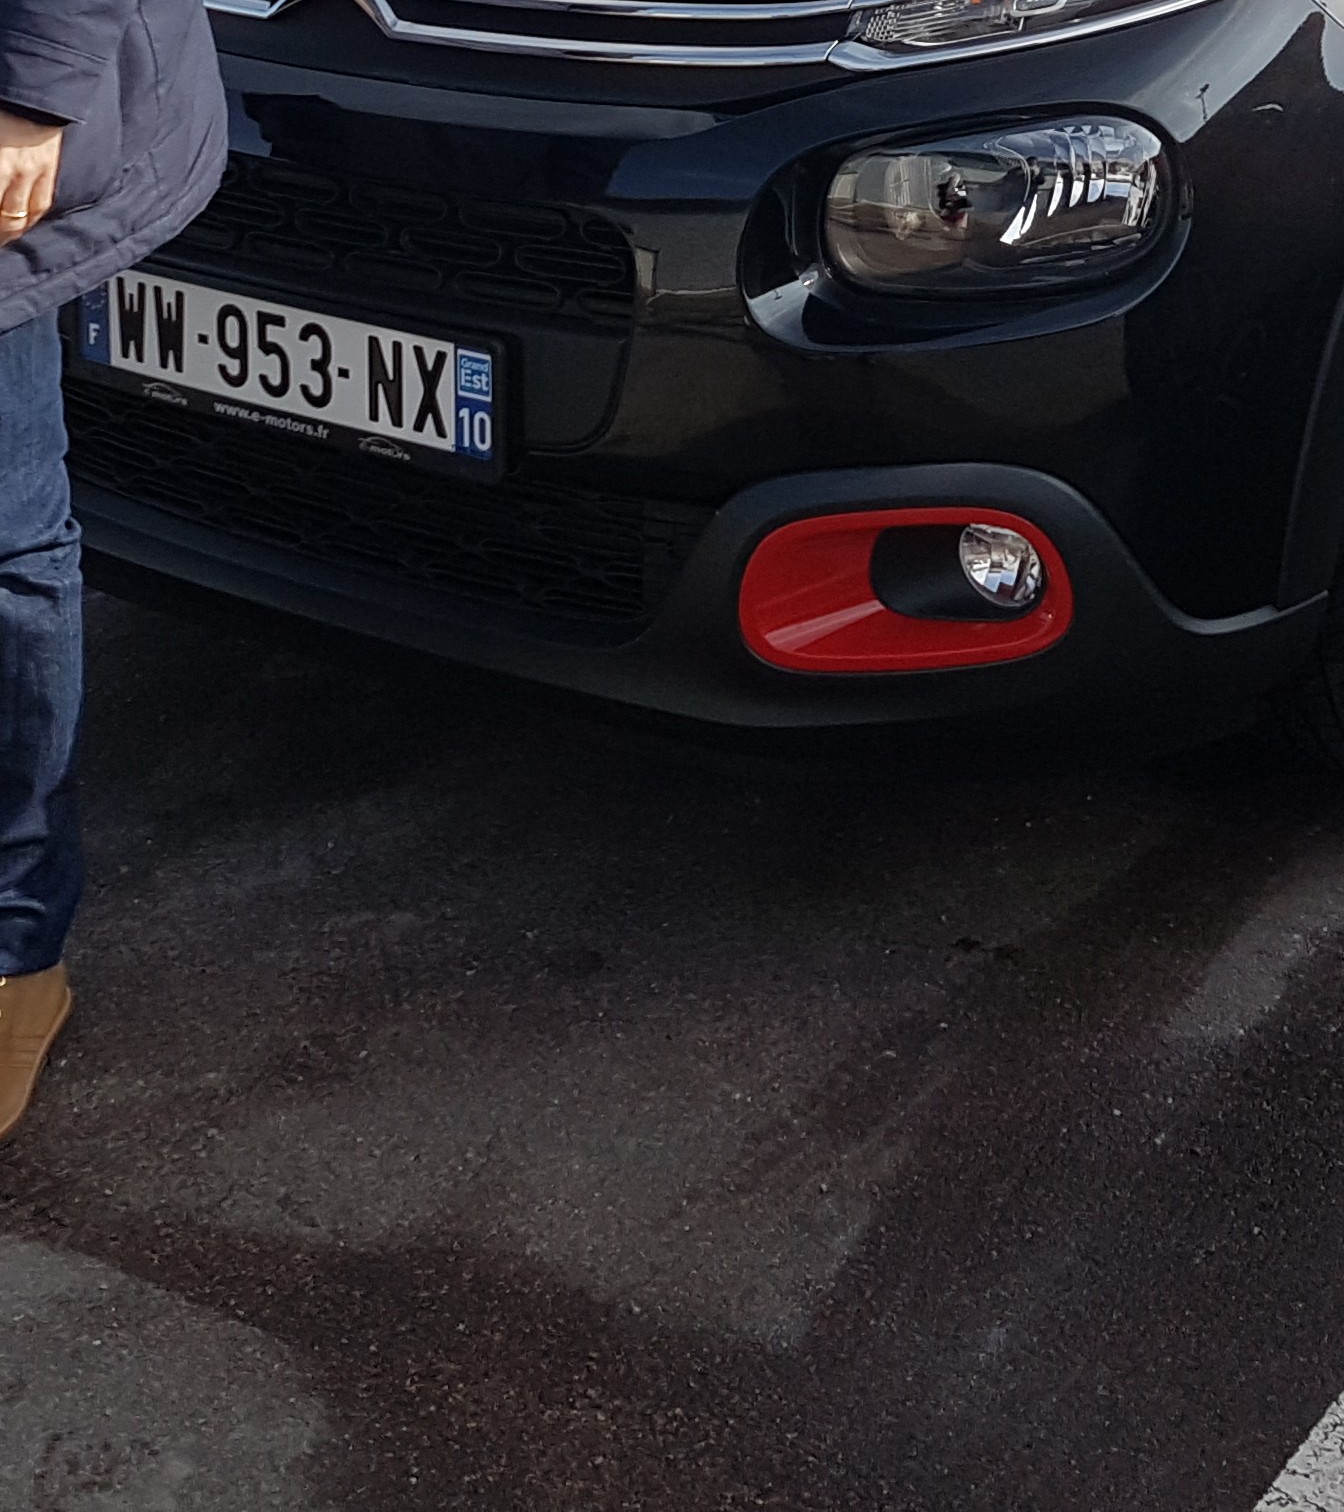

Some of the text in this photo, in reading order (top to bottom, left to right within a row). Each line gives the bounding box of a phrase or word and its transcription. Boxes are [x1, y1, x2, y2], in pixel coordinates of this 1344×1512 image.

[88, 322, 100, 345] F
[116, 276, 447, 439] WW-953-NX
[460, 356, 489, 373] Grand
[460, 369, 489, 392] Est
[213, 402, 330, 440] www.e-motors.fr
[458, 407, 492, 452] 10
